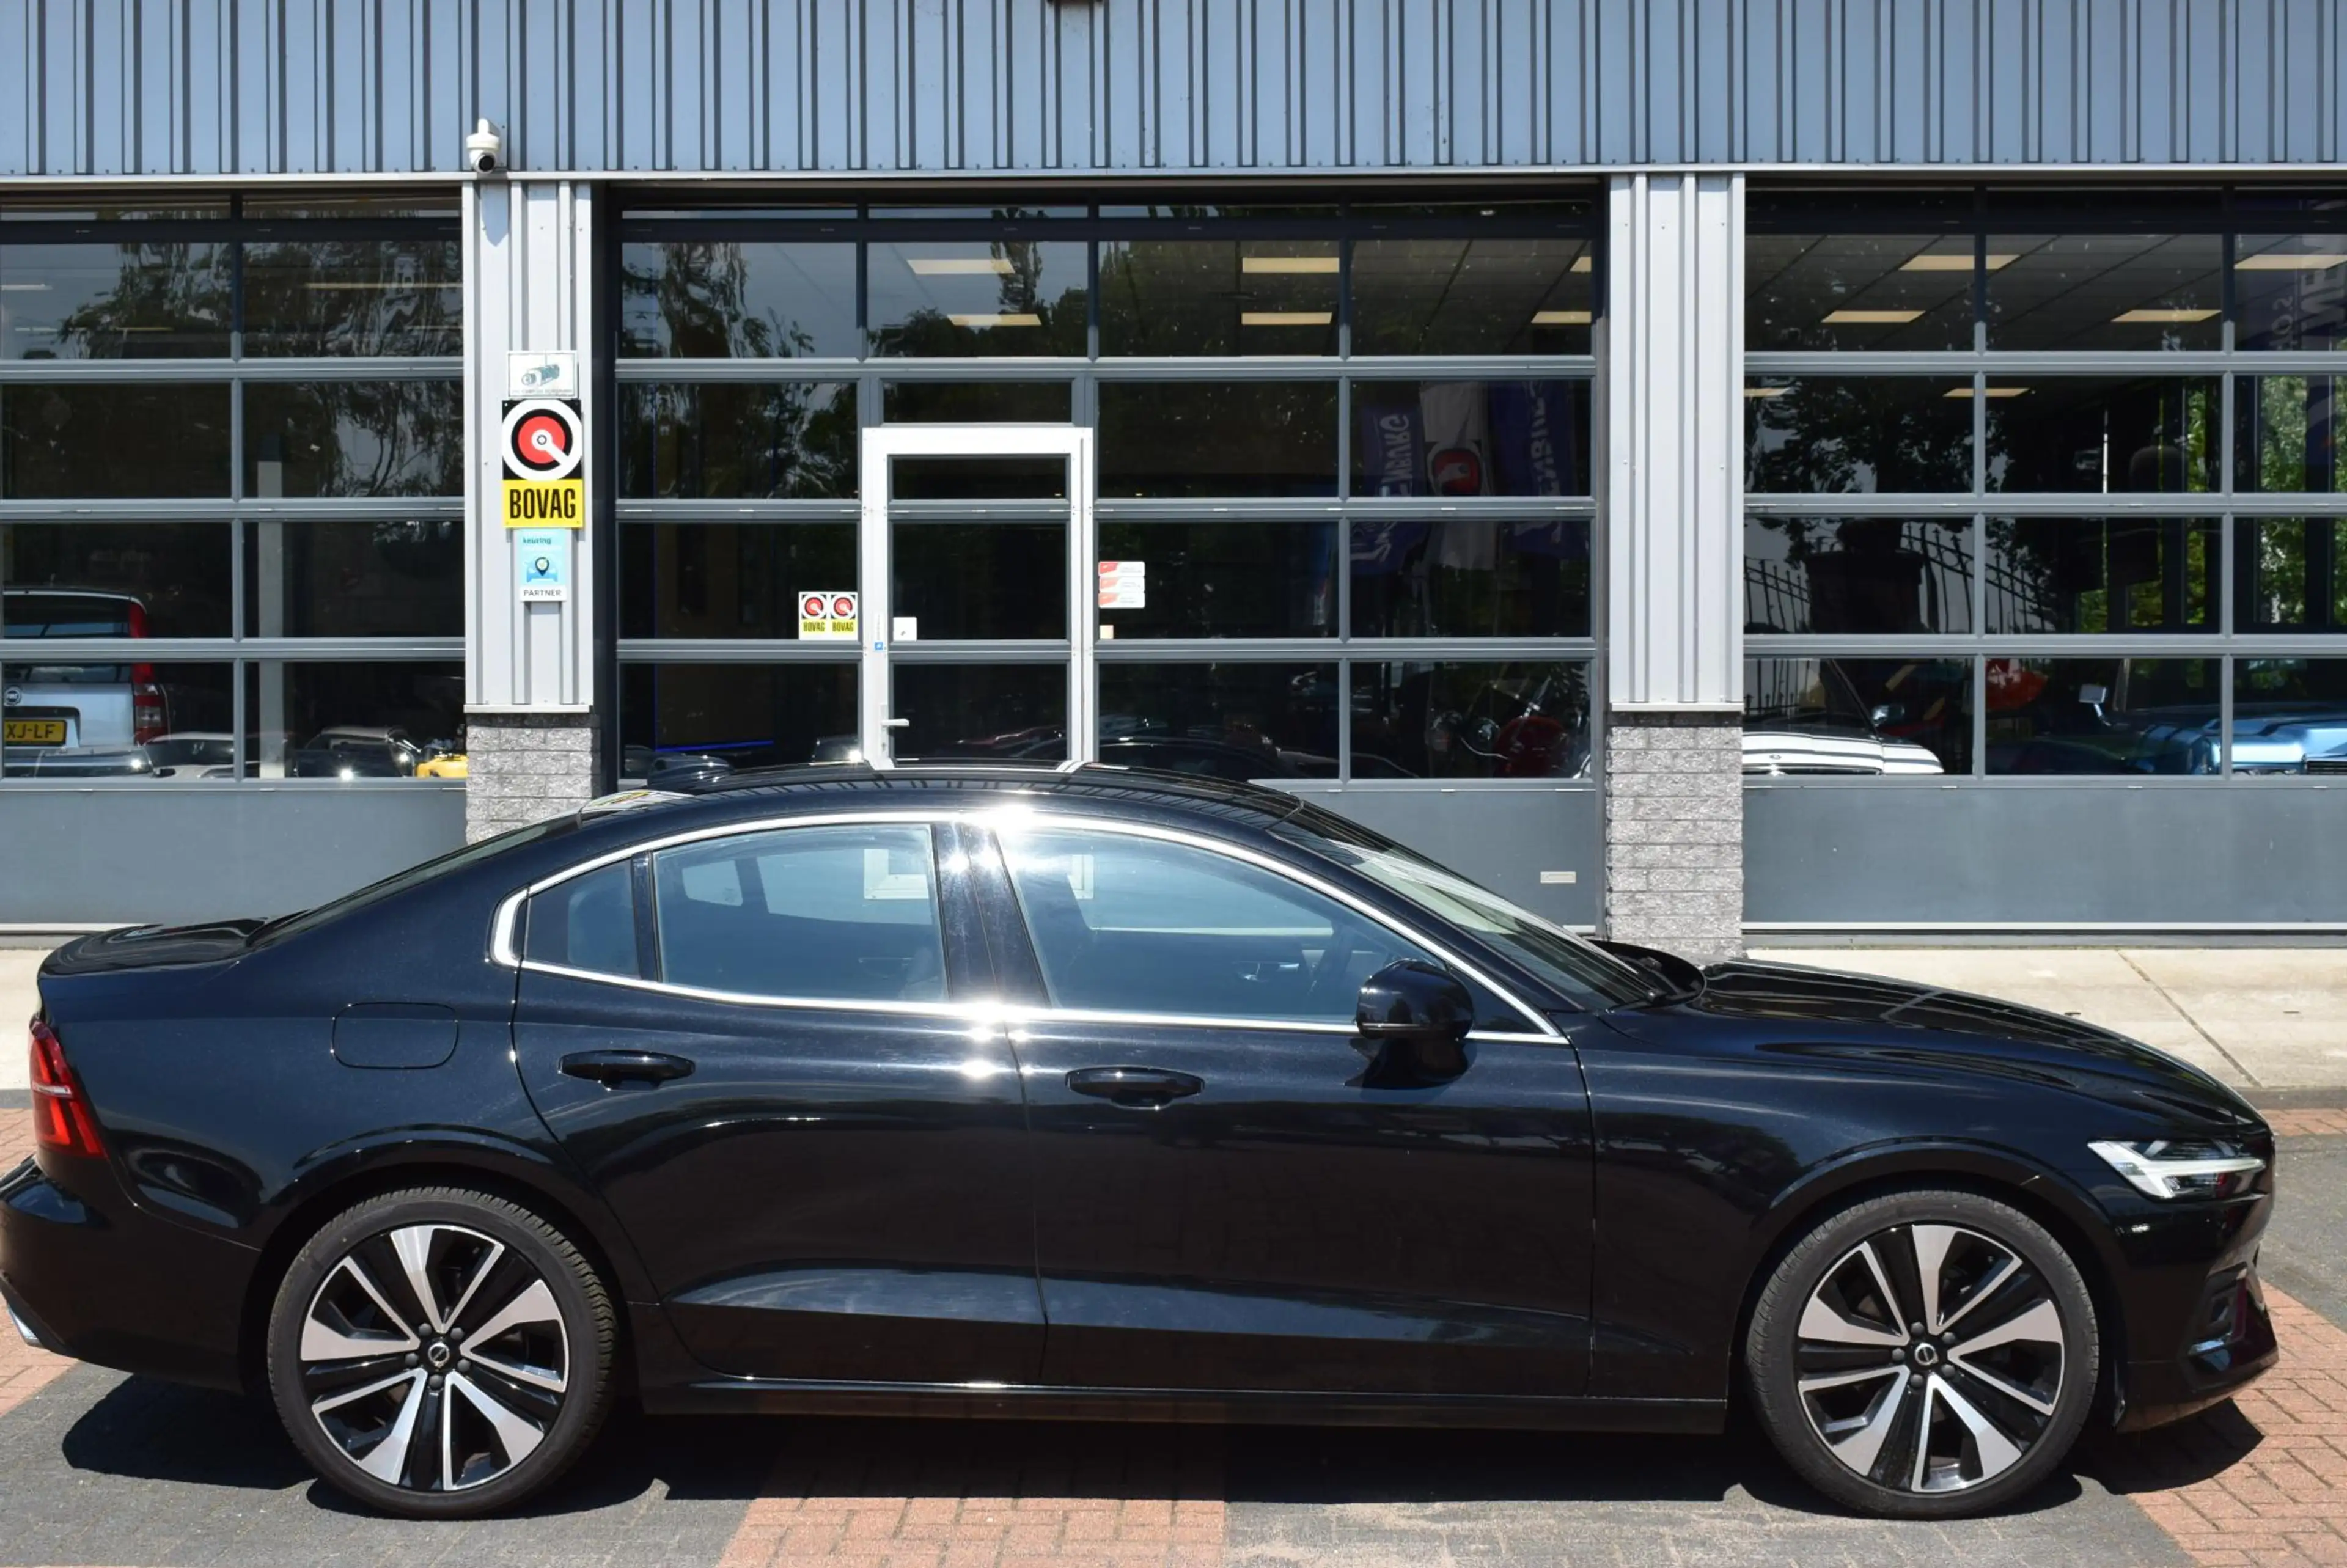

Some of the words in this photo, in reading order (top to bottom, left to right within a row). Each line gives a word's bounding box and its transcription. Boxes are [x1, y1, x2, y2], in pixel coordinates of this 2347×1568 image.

[510, 488, 576, 519] BOVAG
[803, 621, 825, 632] BOVAG
[832, 621, 854, 632] BOVAG
[6, 723, 56, 739] XJ-LF
